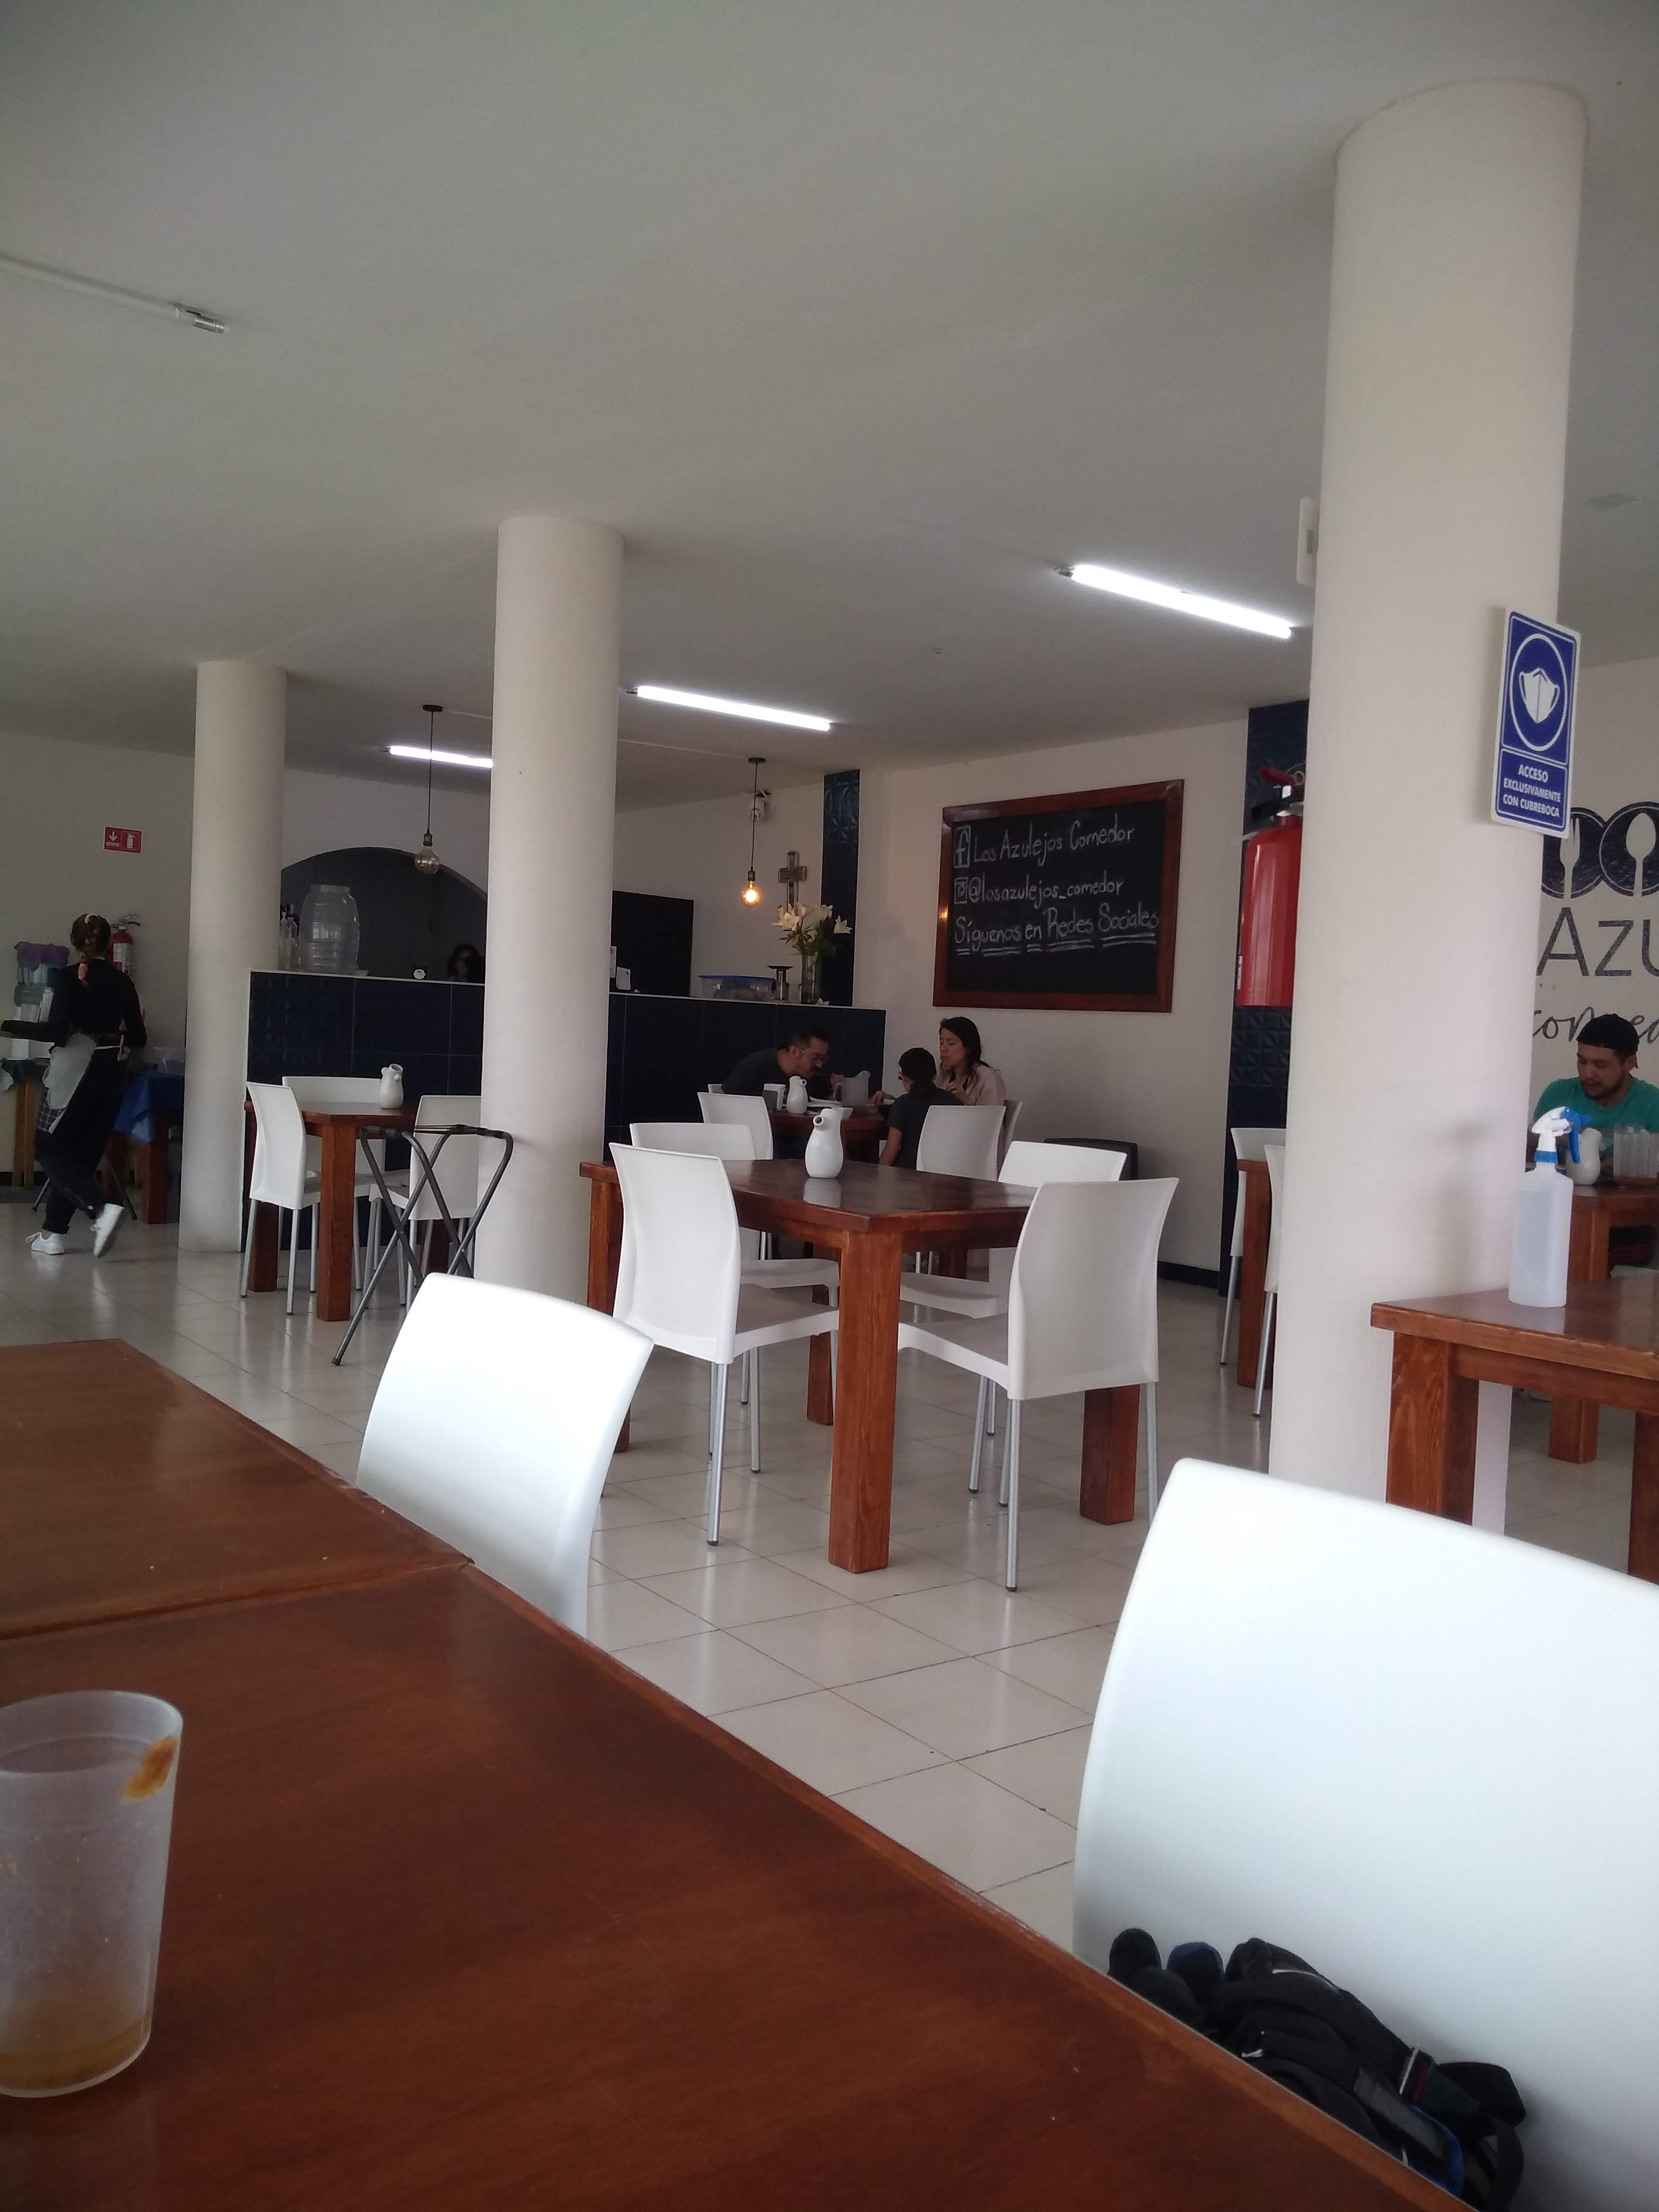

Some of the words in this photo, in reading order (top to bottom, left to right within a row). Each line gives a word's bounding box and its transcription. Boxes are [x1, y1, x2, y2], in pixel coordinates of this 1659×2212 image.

[1503, 777, 1561, 802] EXCLUSIVAMENTE
[1518, 764, 1548, 783] ACCESO
[1503, 793, 1519, 807] CON
[1520, 798, 1560, 818] CUBREBOCA
[974, 834, 996, 862] Los
[1000, 822, 1063, 867] Azulejos
[1069, 812, 1135, 850] Comedor
[968, 870, 1123, 909] @losazulejos_comedor
[1025, 923, 1042, 940] en
[1043, 907, 1094, 937] Redes
[1098, 901, 1159, 932] Sociales
